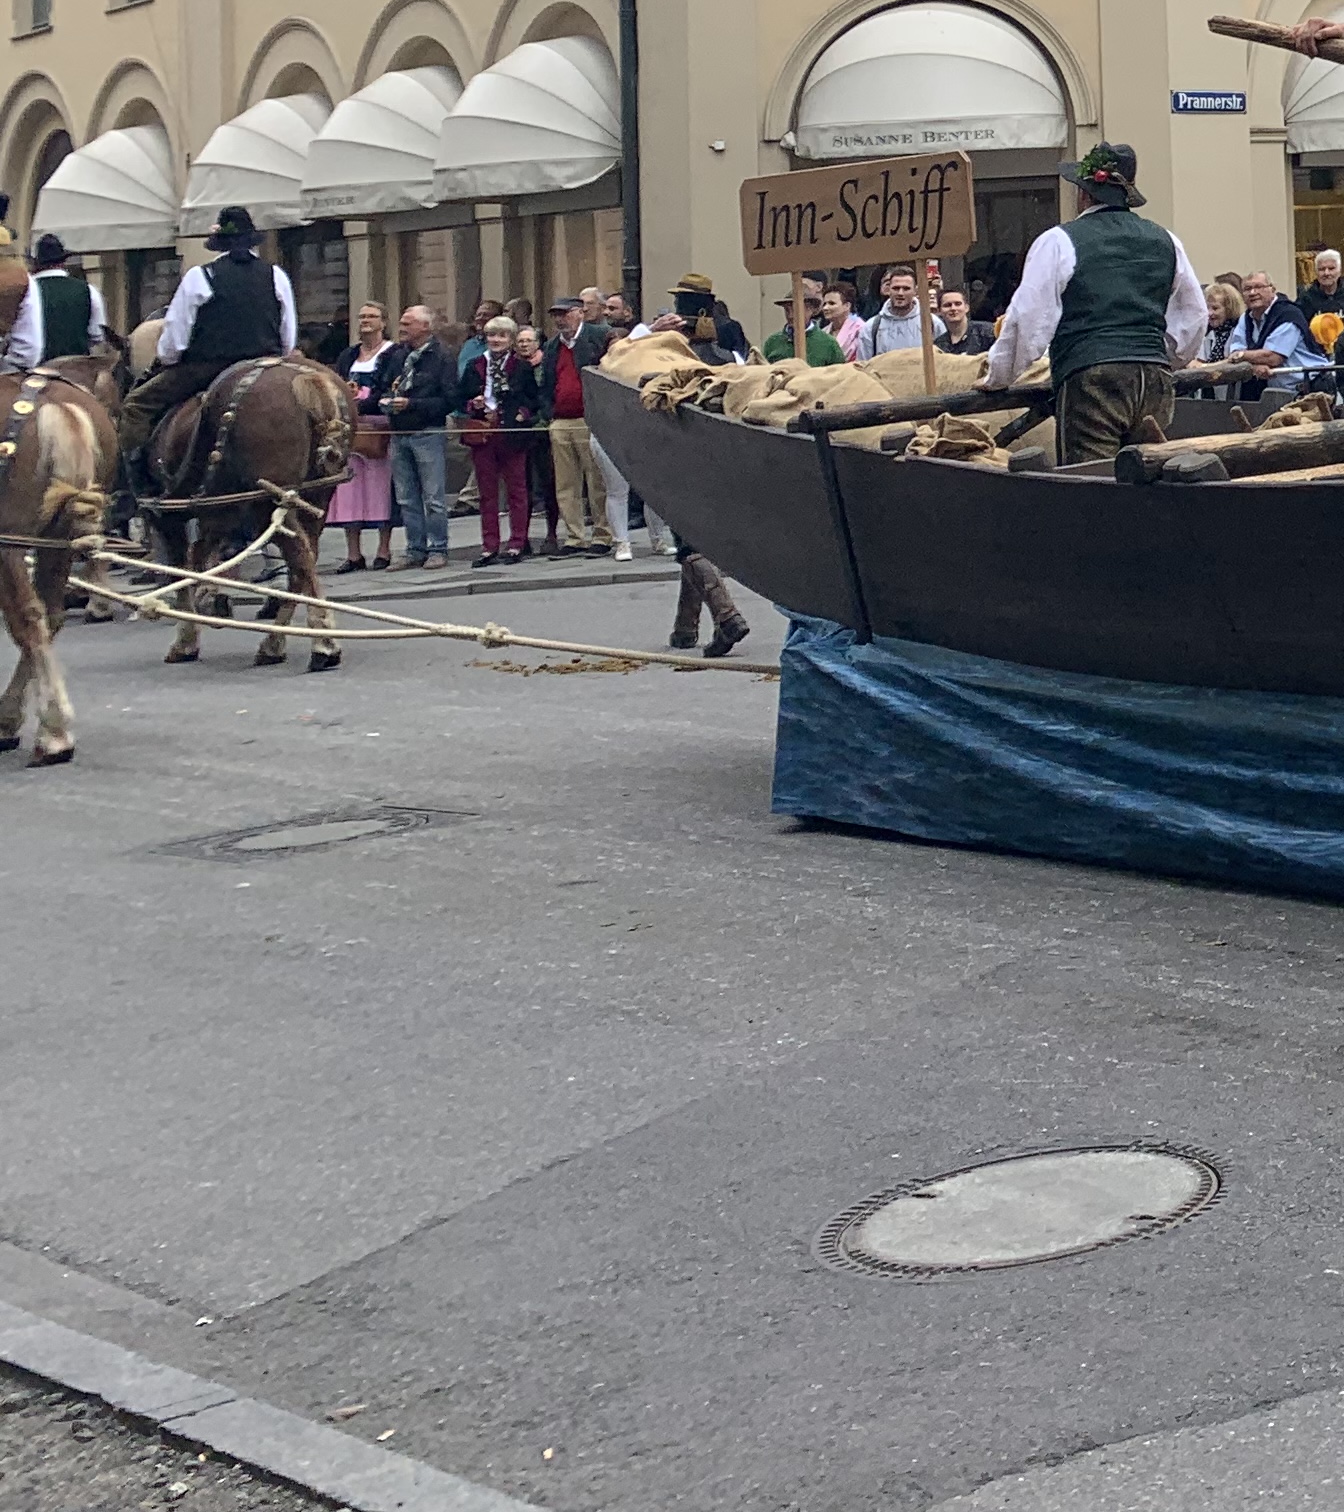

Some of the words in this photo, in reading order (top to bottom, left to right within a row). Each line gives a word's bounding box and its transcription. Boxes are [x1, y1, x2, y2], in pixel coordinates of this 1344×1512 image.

[1177, 92, 1244, 110] Prannerstr.
[921, 128, 996, 144] BENTER
[752, 159, 959, 254] Inn-Schiff
